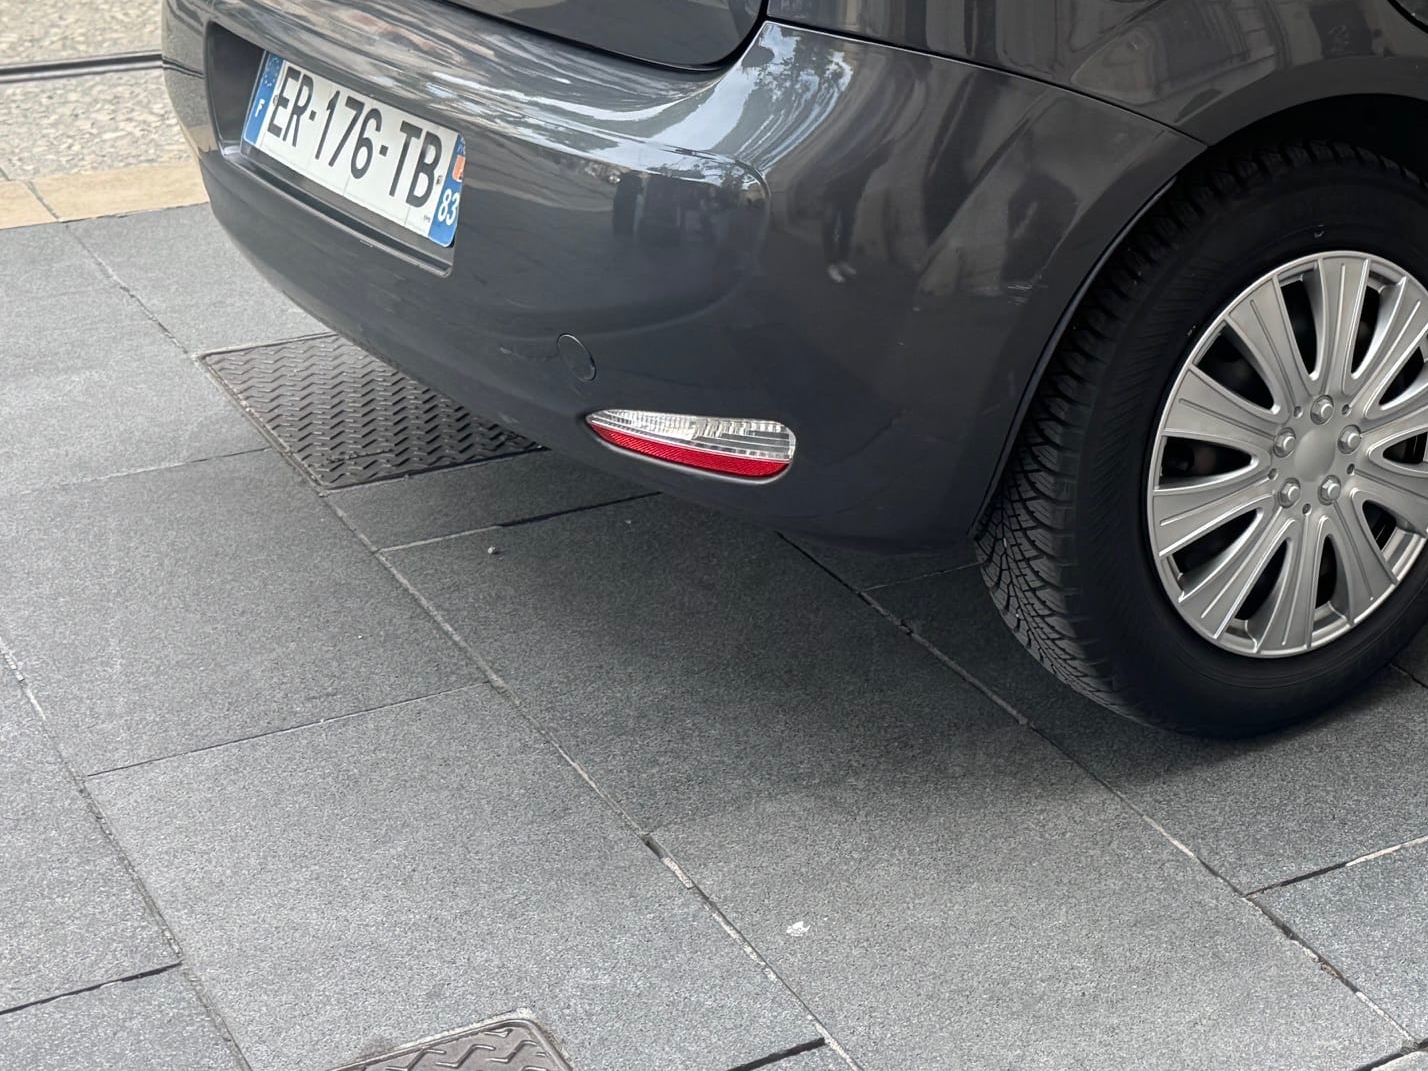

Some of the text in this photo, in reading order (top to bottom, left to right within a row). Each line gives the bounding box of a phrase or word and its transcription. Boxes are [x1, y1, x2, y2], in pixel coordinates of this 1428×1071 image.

[254, 99, 265, 117] F
[267, 66, 443, 208] ER-176-TB
[437, 189, 460, 226] 83
